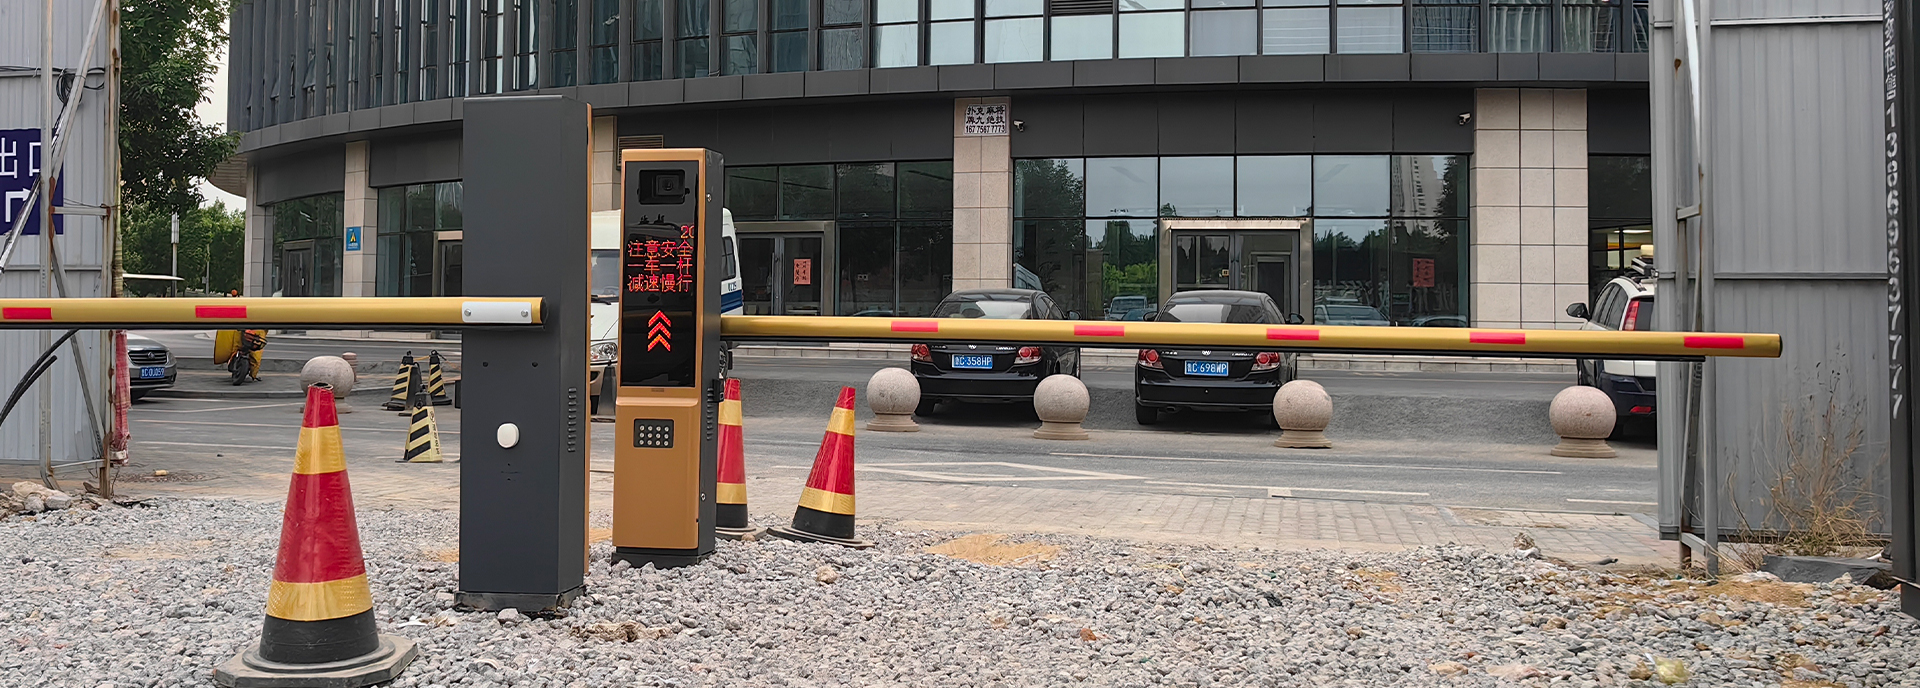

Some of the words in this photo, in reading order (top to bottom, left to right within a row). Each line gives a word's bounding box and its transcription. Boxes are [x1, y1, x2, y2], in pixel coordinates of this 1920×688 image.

[627, 239, 694, 258] 注意安全
[627, 256, 694, 275] 一车一杆
[627, 273, 693, 293] 减速慢行
